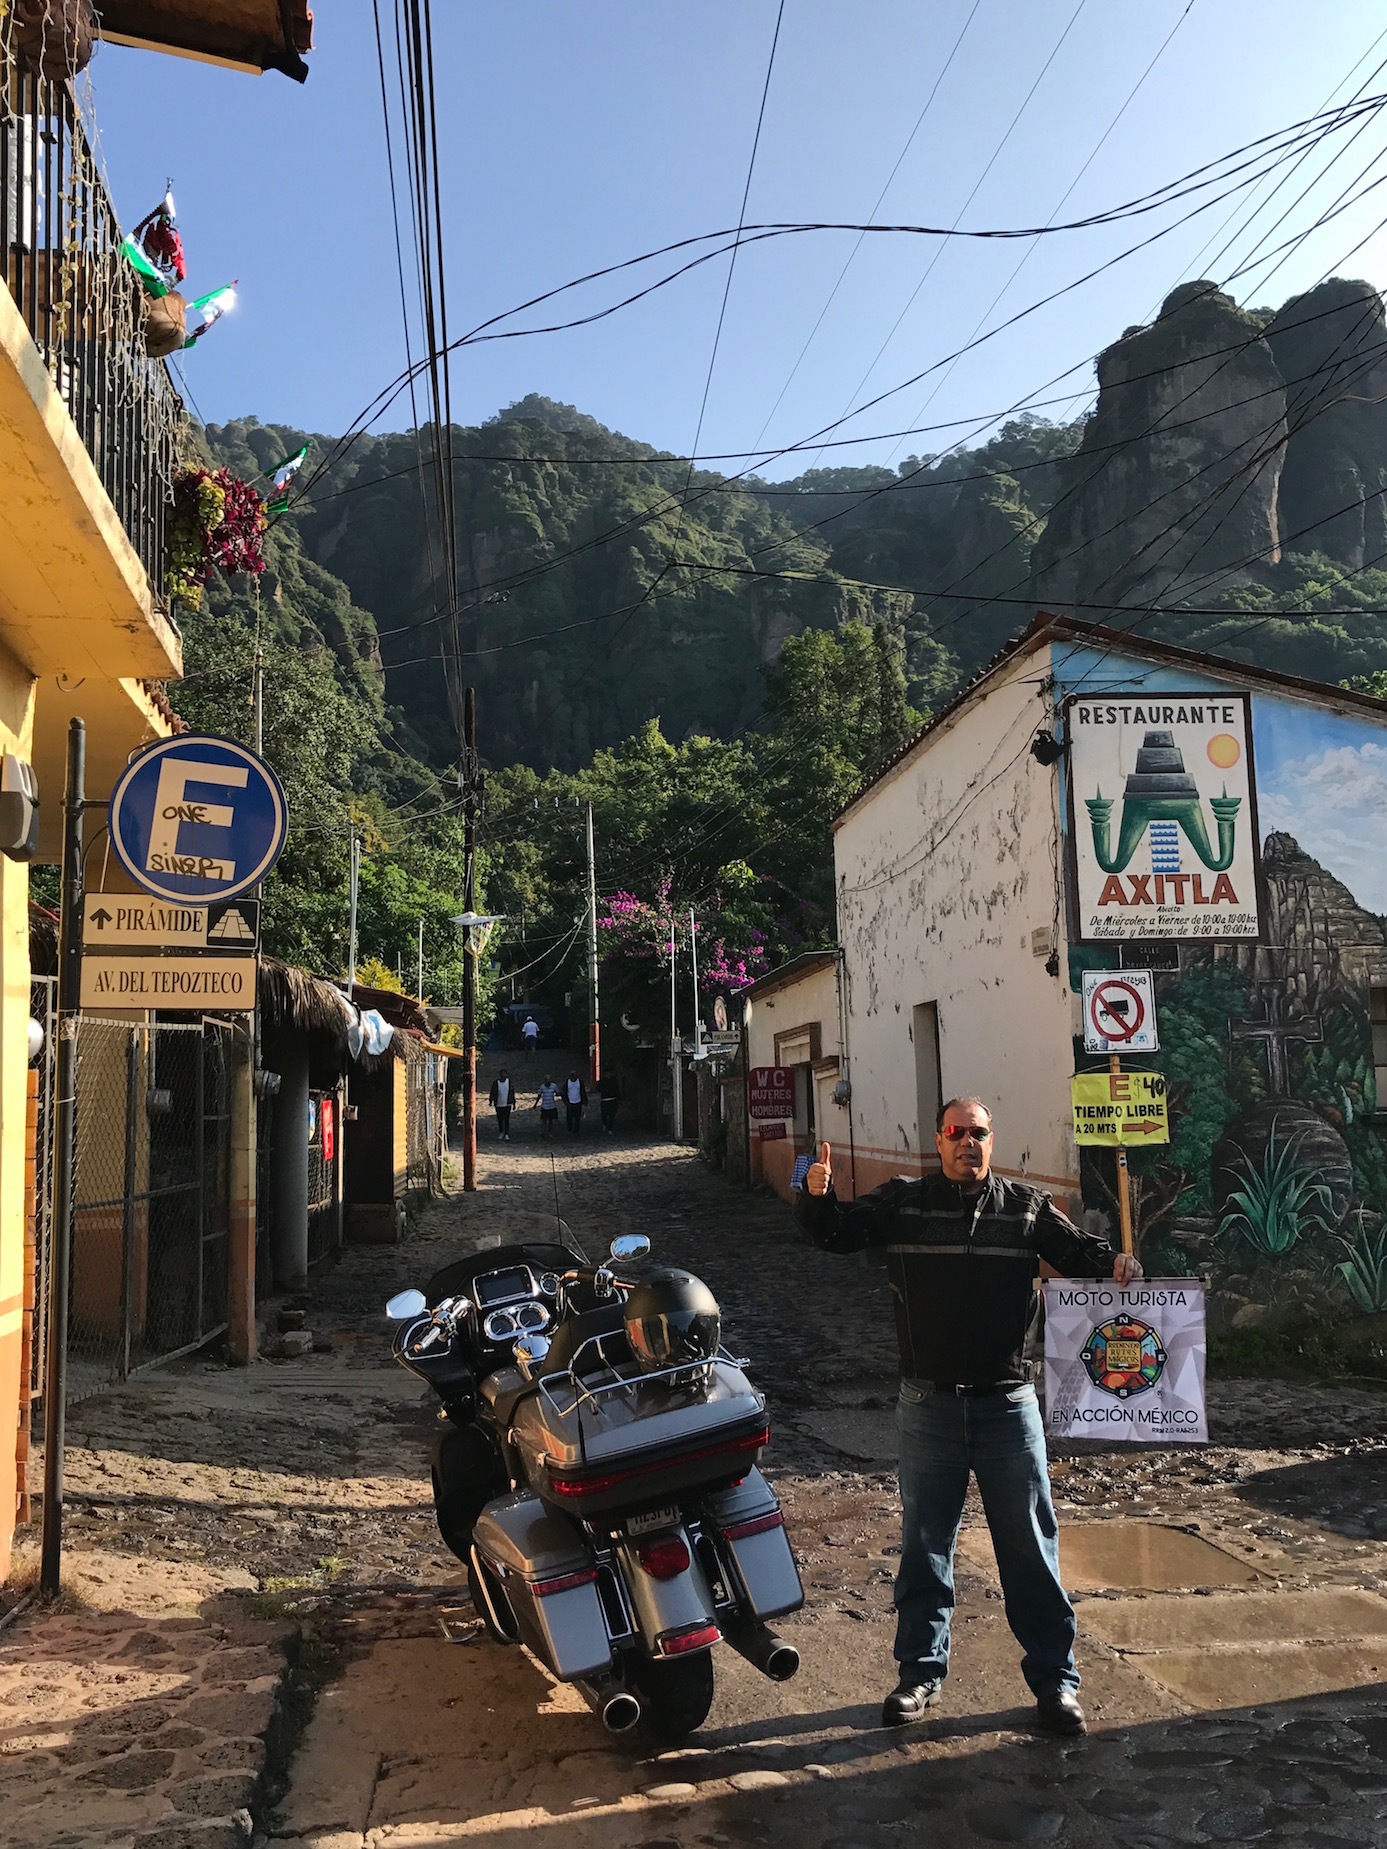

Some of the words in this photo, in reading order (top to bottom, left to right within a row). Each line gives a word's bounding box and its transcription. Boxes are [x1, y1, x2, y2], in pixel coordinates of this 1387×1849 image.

[1078, 706, 1234, 725] RESTAURANTE
[145, 757, 249, 882] E
[162, 804, 212, 824] ONE
[1097, 873, 1240, 906] AXITLA
[115, 902, 204, 933] PIRÁMIDE
[1090, 915, 1103, 926] De
[1158, 915, 1190, 925] Viernes
[1190, 914, 1202, 924] de
[1202, 914, 1221, 924] 10:00
[1227, 914, 1246, 924] 19:00
[1092, 926, 1126, 936] Sábado
[1130, 928, 1136, 938] y
[1193, 925, 1211, 935] 9:00
[1214, 927, 1219, 935] a
[1222, 925, 1242, 934] 19:00
[93, 971, 115, 993] AV.
[118, 971, 149, 993] DEL
[152, 972, 243, 994] TEPOZTECO
[751, 1089, 792, 1100] MUJERES
[1109, 1075, 1131, 1100] E
[751, 1105, 793, 1116] HOMBRES
[1074, 1105, 1123, 1118] TIEMPO
[1127, 1104, 1164, 1117] LIBRE
[1075, 1124, 1082, 1134] A
[1083, 1123, 1095, 1133] 20
[1097, 1123, 1117, 1133] MTS
[1059, 1291, 1113, 1306] MOTO
[1119, 1291, 1187, 1306] TURISTA
[1052, 1410, 1069, 1423] EN
[1072, 1405, 1134, 1422] ACCIÓN
[1138, 1408, 1198, 1424] MÉXICO
